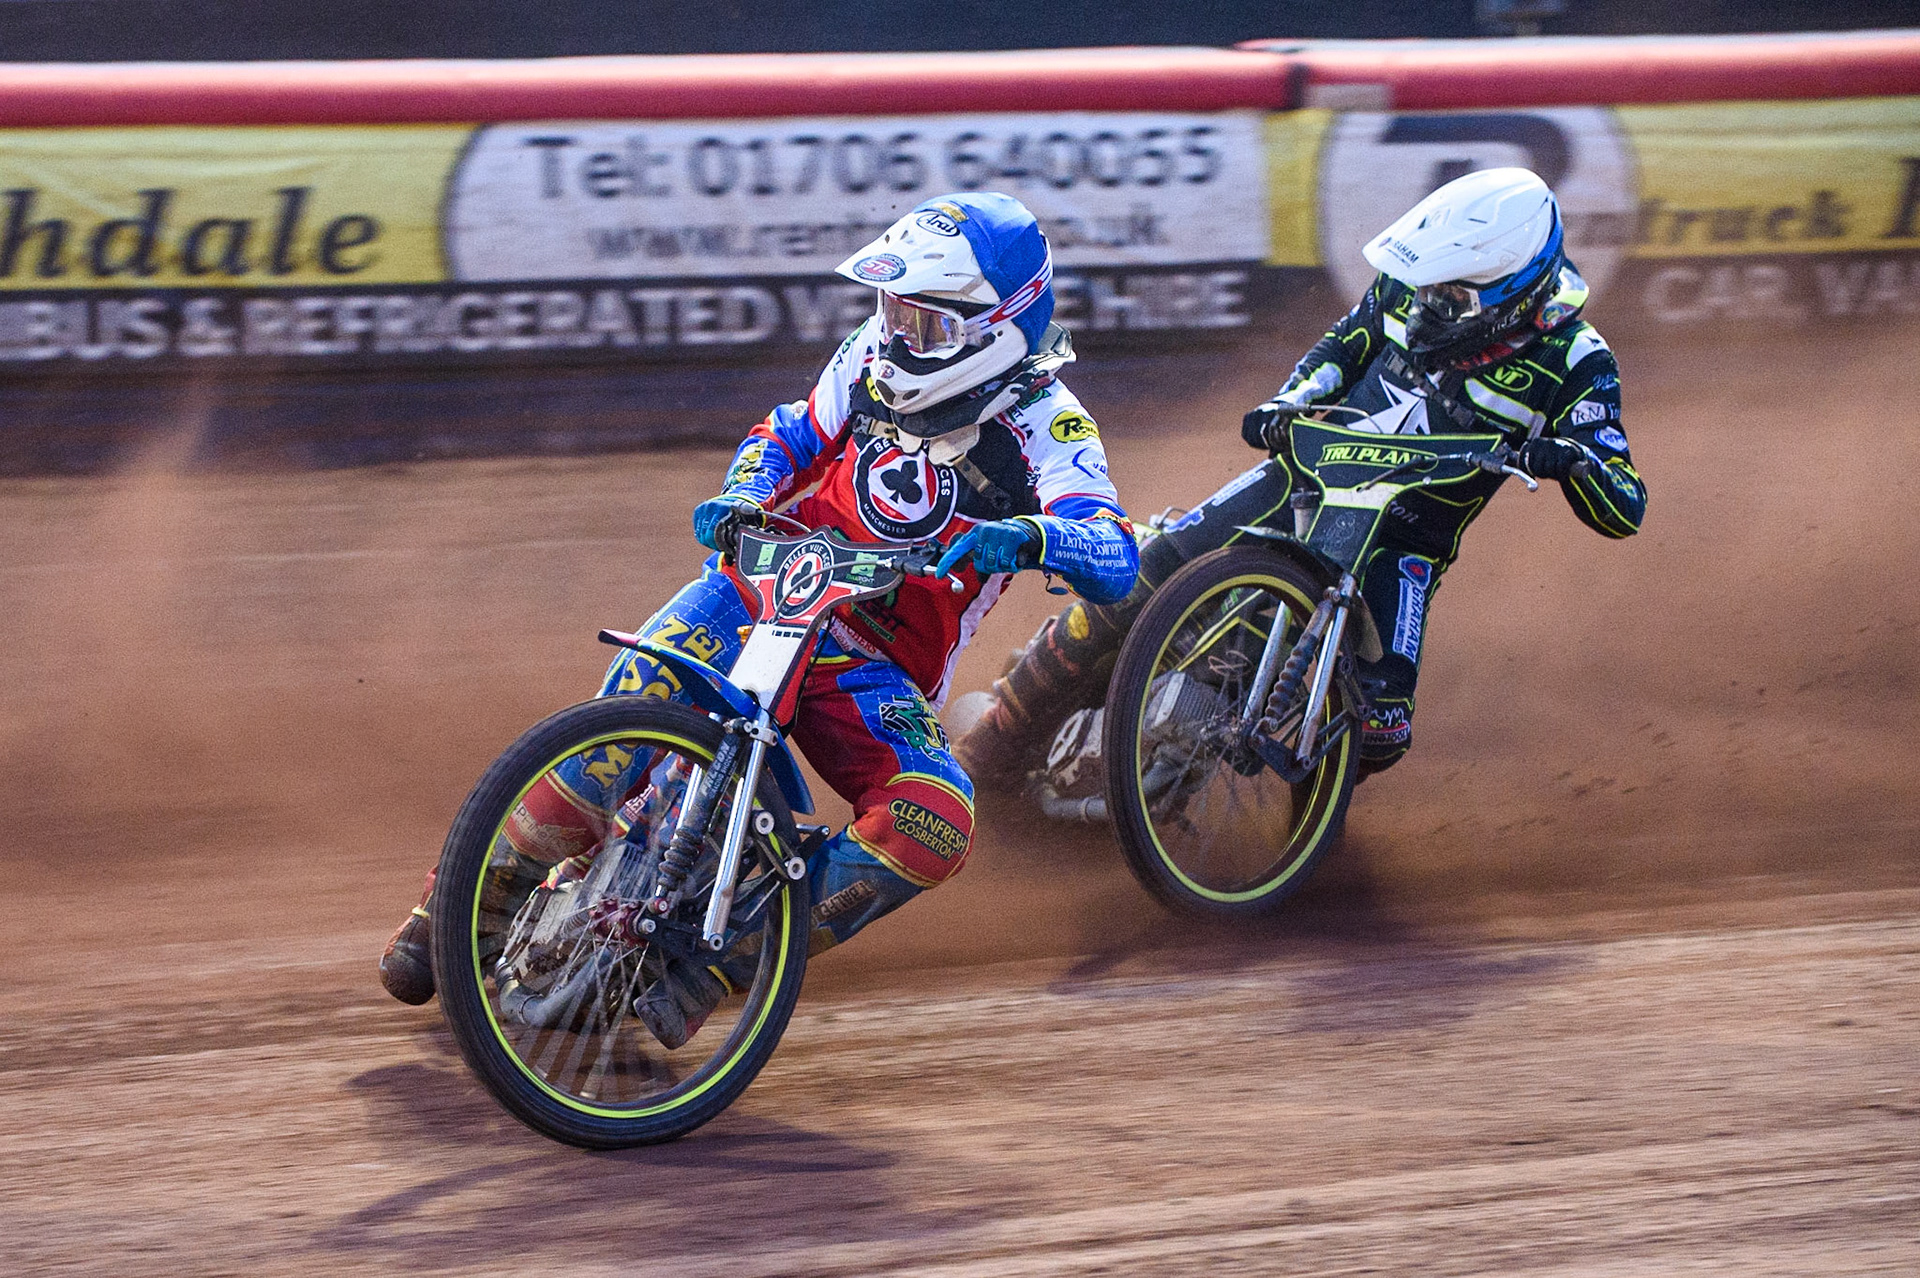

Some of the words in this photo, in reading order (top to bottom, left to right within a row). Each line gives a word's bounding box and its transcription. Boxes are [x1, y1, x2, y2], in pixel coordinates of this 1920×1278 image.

[688, 131, 930, 197] 01706
[945, 126, 1222, 190] 640055
[926, 214, 957, 233] Arai
[860, 259, 898, 275] STS
[1323, 446, 1358, 462] TRU
[1357, 447, 1434, 466] PLAN
[937, 465, 952, 496] CES
[863, 502, 907, 534] MANCHESTER
[783, 546, 807, 571] BELLE
[809, 543, 824, 554] VUE
[1404, 585, 1422, 660] GRAHAM
[699, 739, 731, 798] FALCON
[890, 799, 968, 853] CLEANFRESH
[895, 818, 956, 860] GOSBERTON
